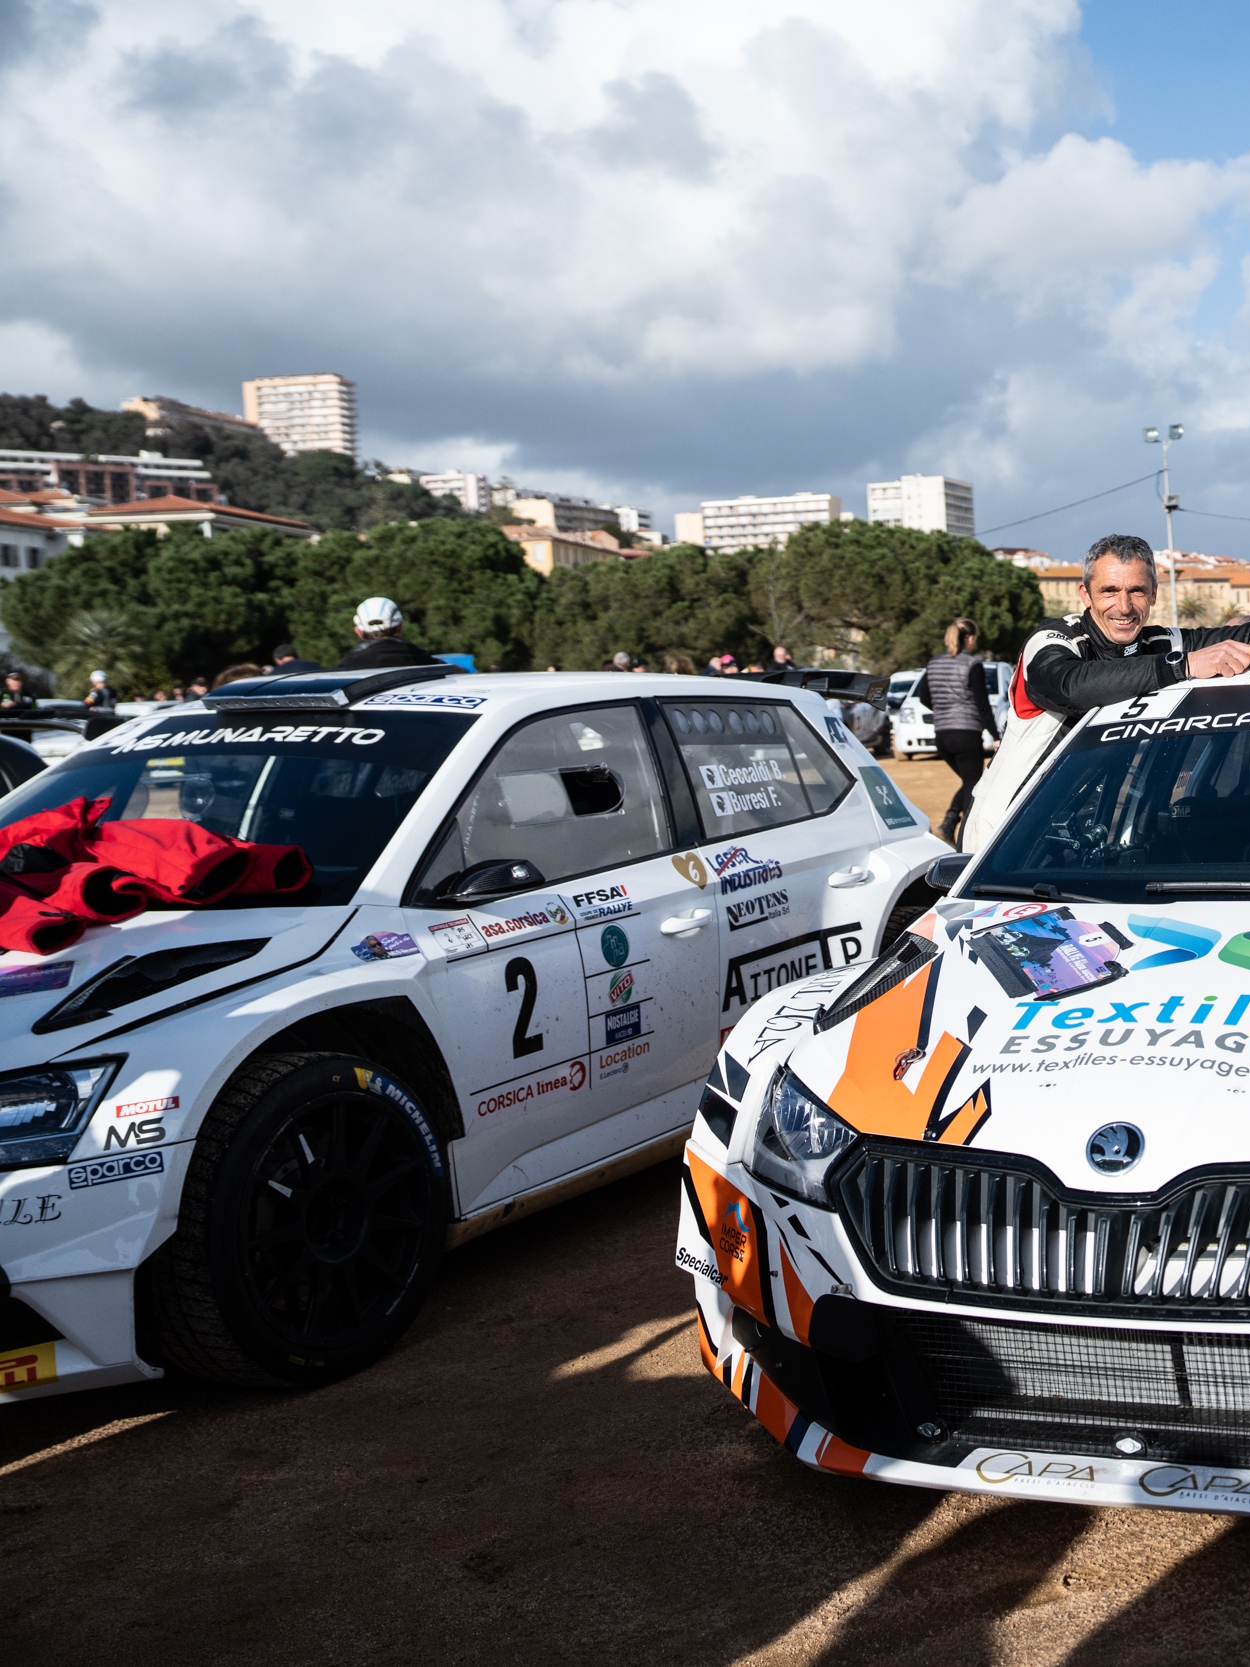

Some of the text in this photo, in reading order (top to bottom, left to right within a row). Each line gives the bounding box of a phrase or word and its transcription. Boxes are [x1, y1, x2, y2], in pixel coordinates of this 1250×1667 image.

[373, 694, 482, 705] sparco
[1121, 692, 1159, 719] 5
[162, 726, 386, 748] MUNARETTO
[719, 760, 786, 786] Ceccaldi B.
[728, 786, 782, 812] Buresi F.
[688, 861, 700, 882] 6
[572, 886, 623, 908] FFSA
[598, 901, 633, 918] RALLYE
[726, 889, 789, 923] NEOTENS
[481, 910, 550, 938] asa.corsica
[504, 956, 544, 1059] 2
[607, 1008, 639, 1031] NOSTALGIE
[600, 1042, 650, 1069] Location
[119, 1098, 176, 1117] MOTUL
[477, 1074, 568, 1118] CORSICA linea
[103, 1117, 166, 1151] MS
[385, 1084, 442, 1169] MICHELIN
[69, 1154, 160, 1187] sparco
[721, 1222, 747, 1249] IMPER
[719, 1238, 745, 1263] CORSE
[676, 1246, 729, 1286] Specialcar
[976, 1452, 1096, 1484] CAPA
[1014, 1477, 1096, 1489] PAESI D'AIACCIU
[1179, 1491, 1209, 1501] PAESI
